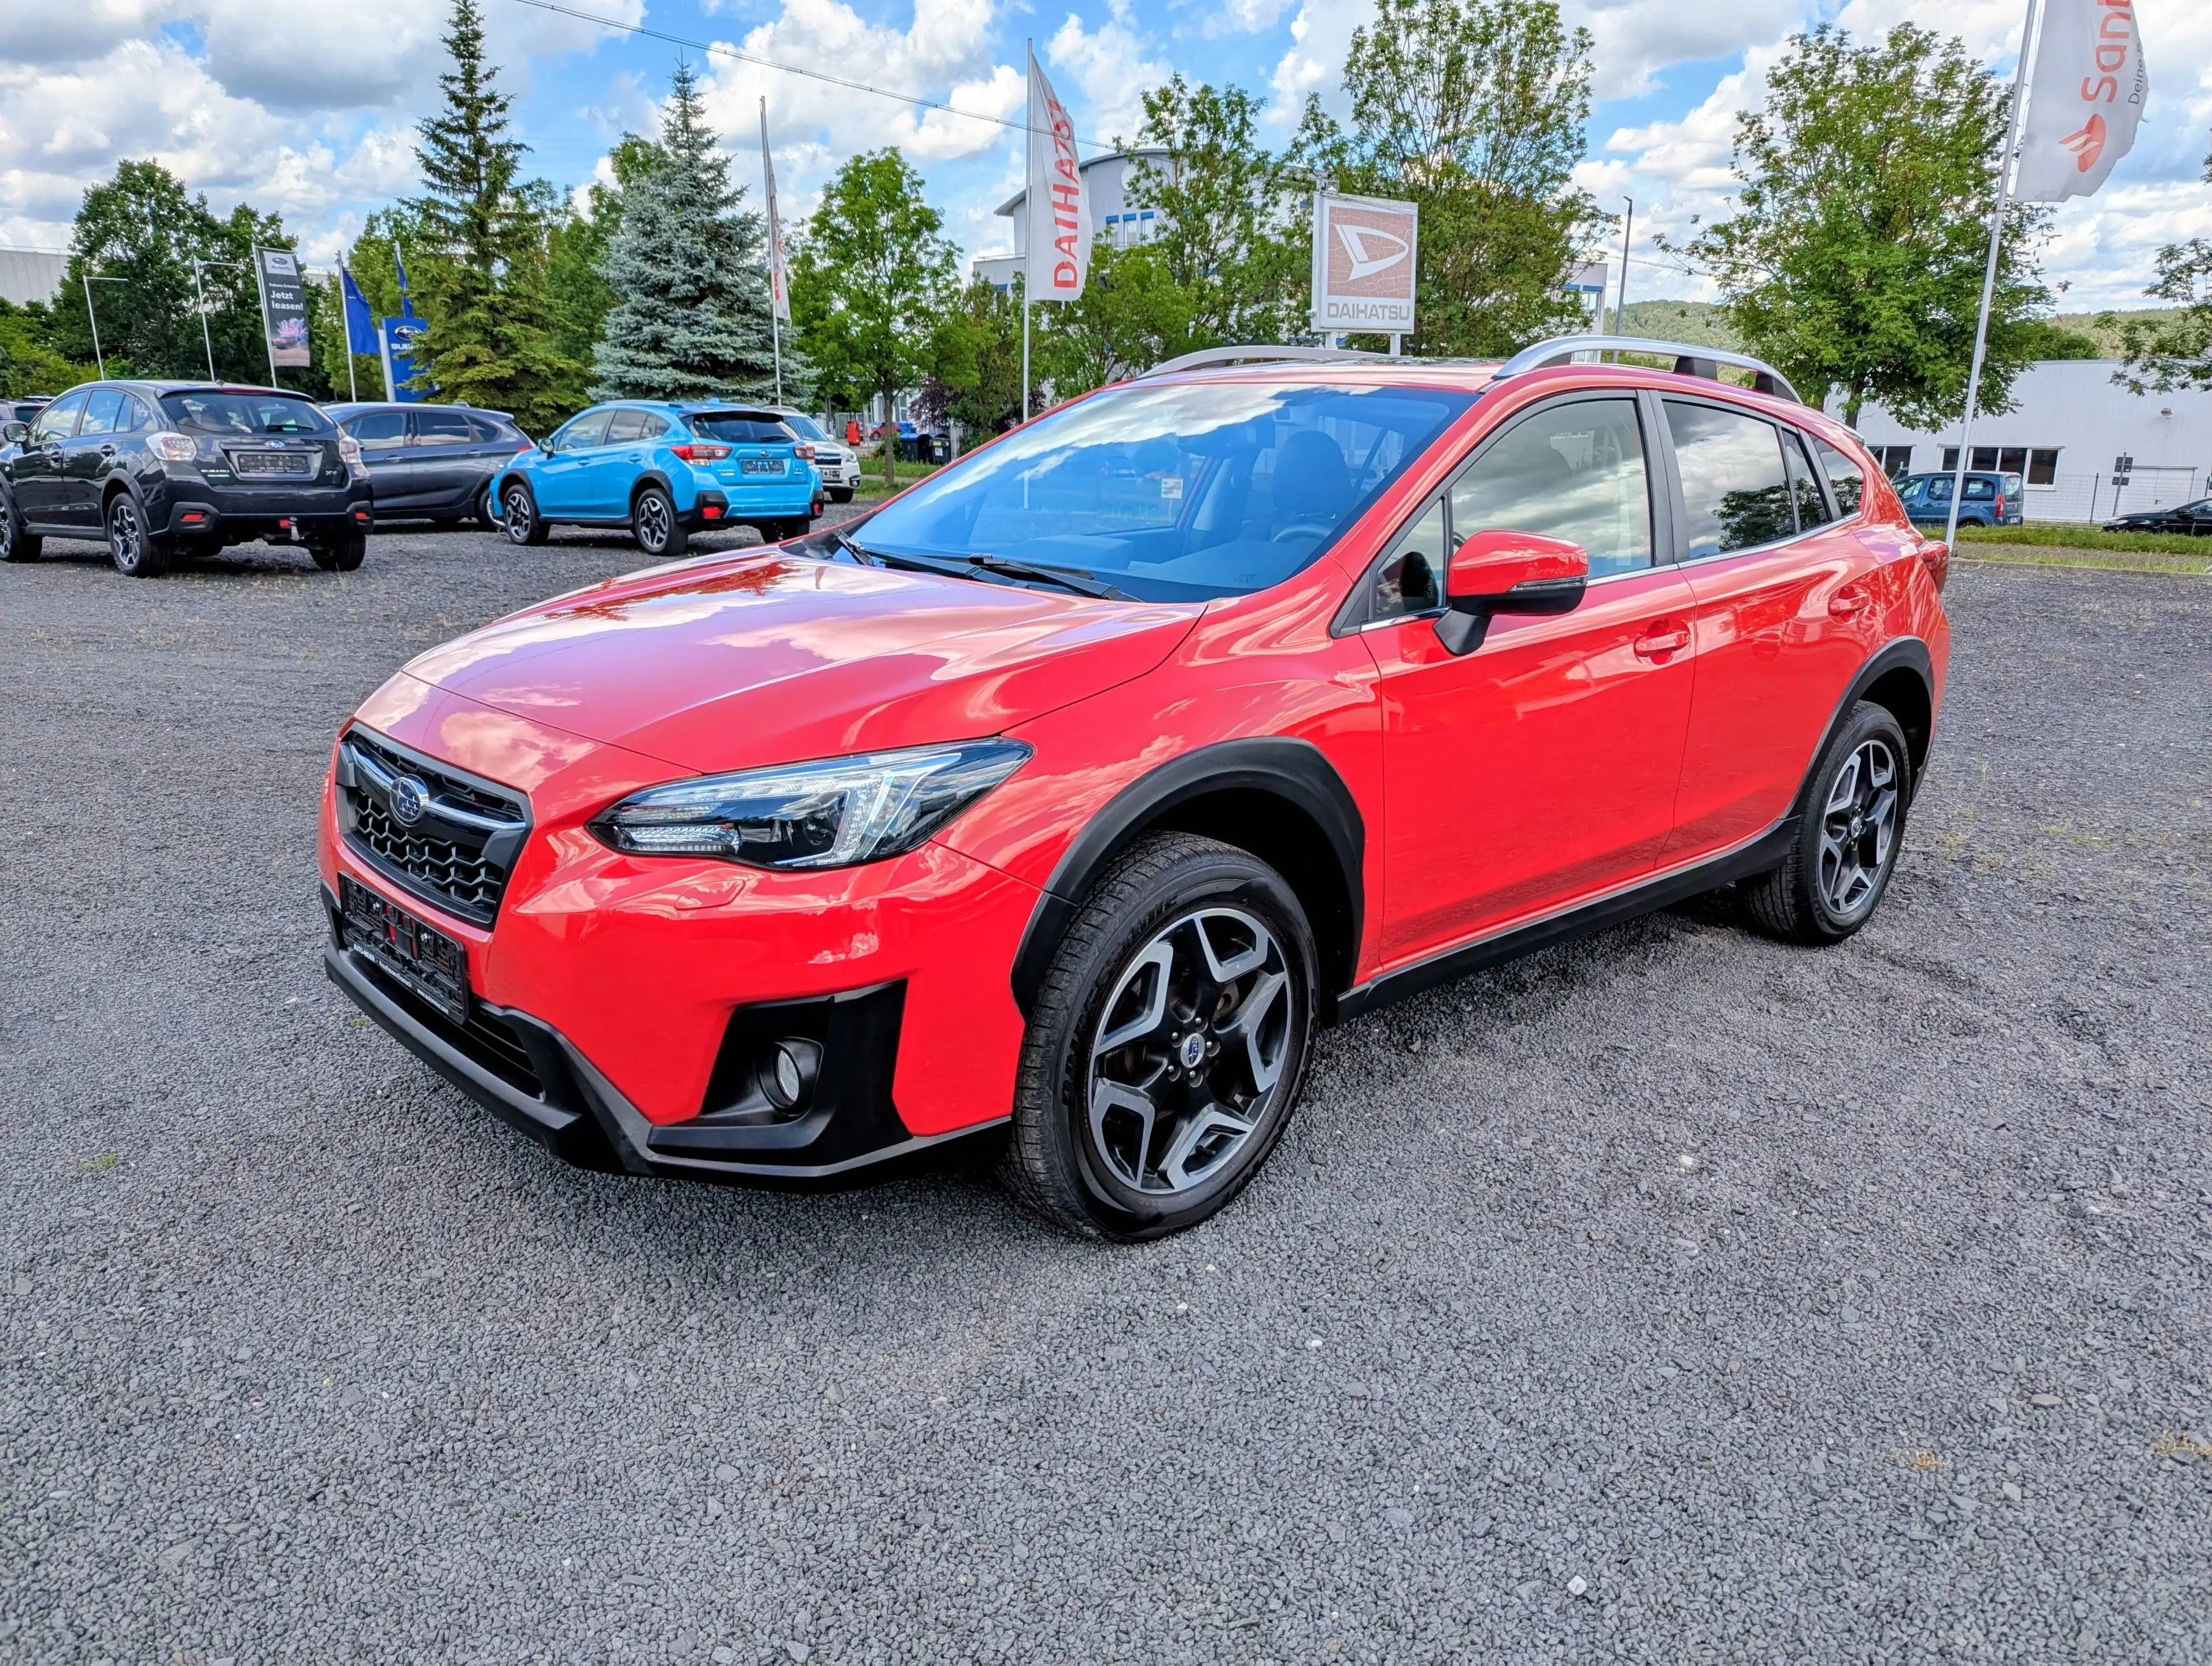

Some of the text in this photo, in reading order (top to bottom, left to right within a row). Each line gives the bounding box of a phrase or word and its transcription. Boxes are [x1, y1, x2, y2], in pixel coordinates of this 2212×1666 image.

[2128, 58, 2144, 105] Deine
[271, 290, 294, 300] Jetzt
[271, 300, 304, 311] leasen!
[1327, 302, 1410, 320] DAIHATSU
